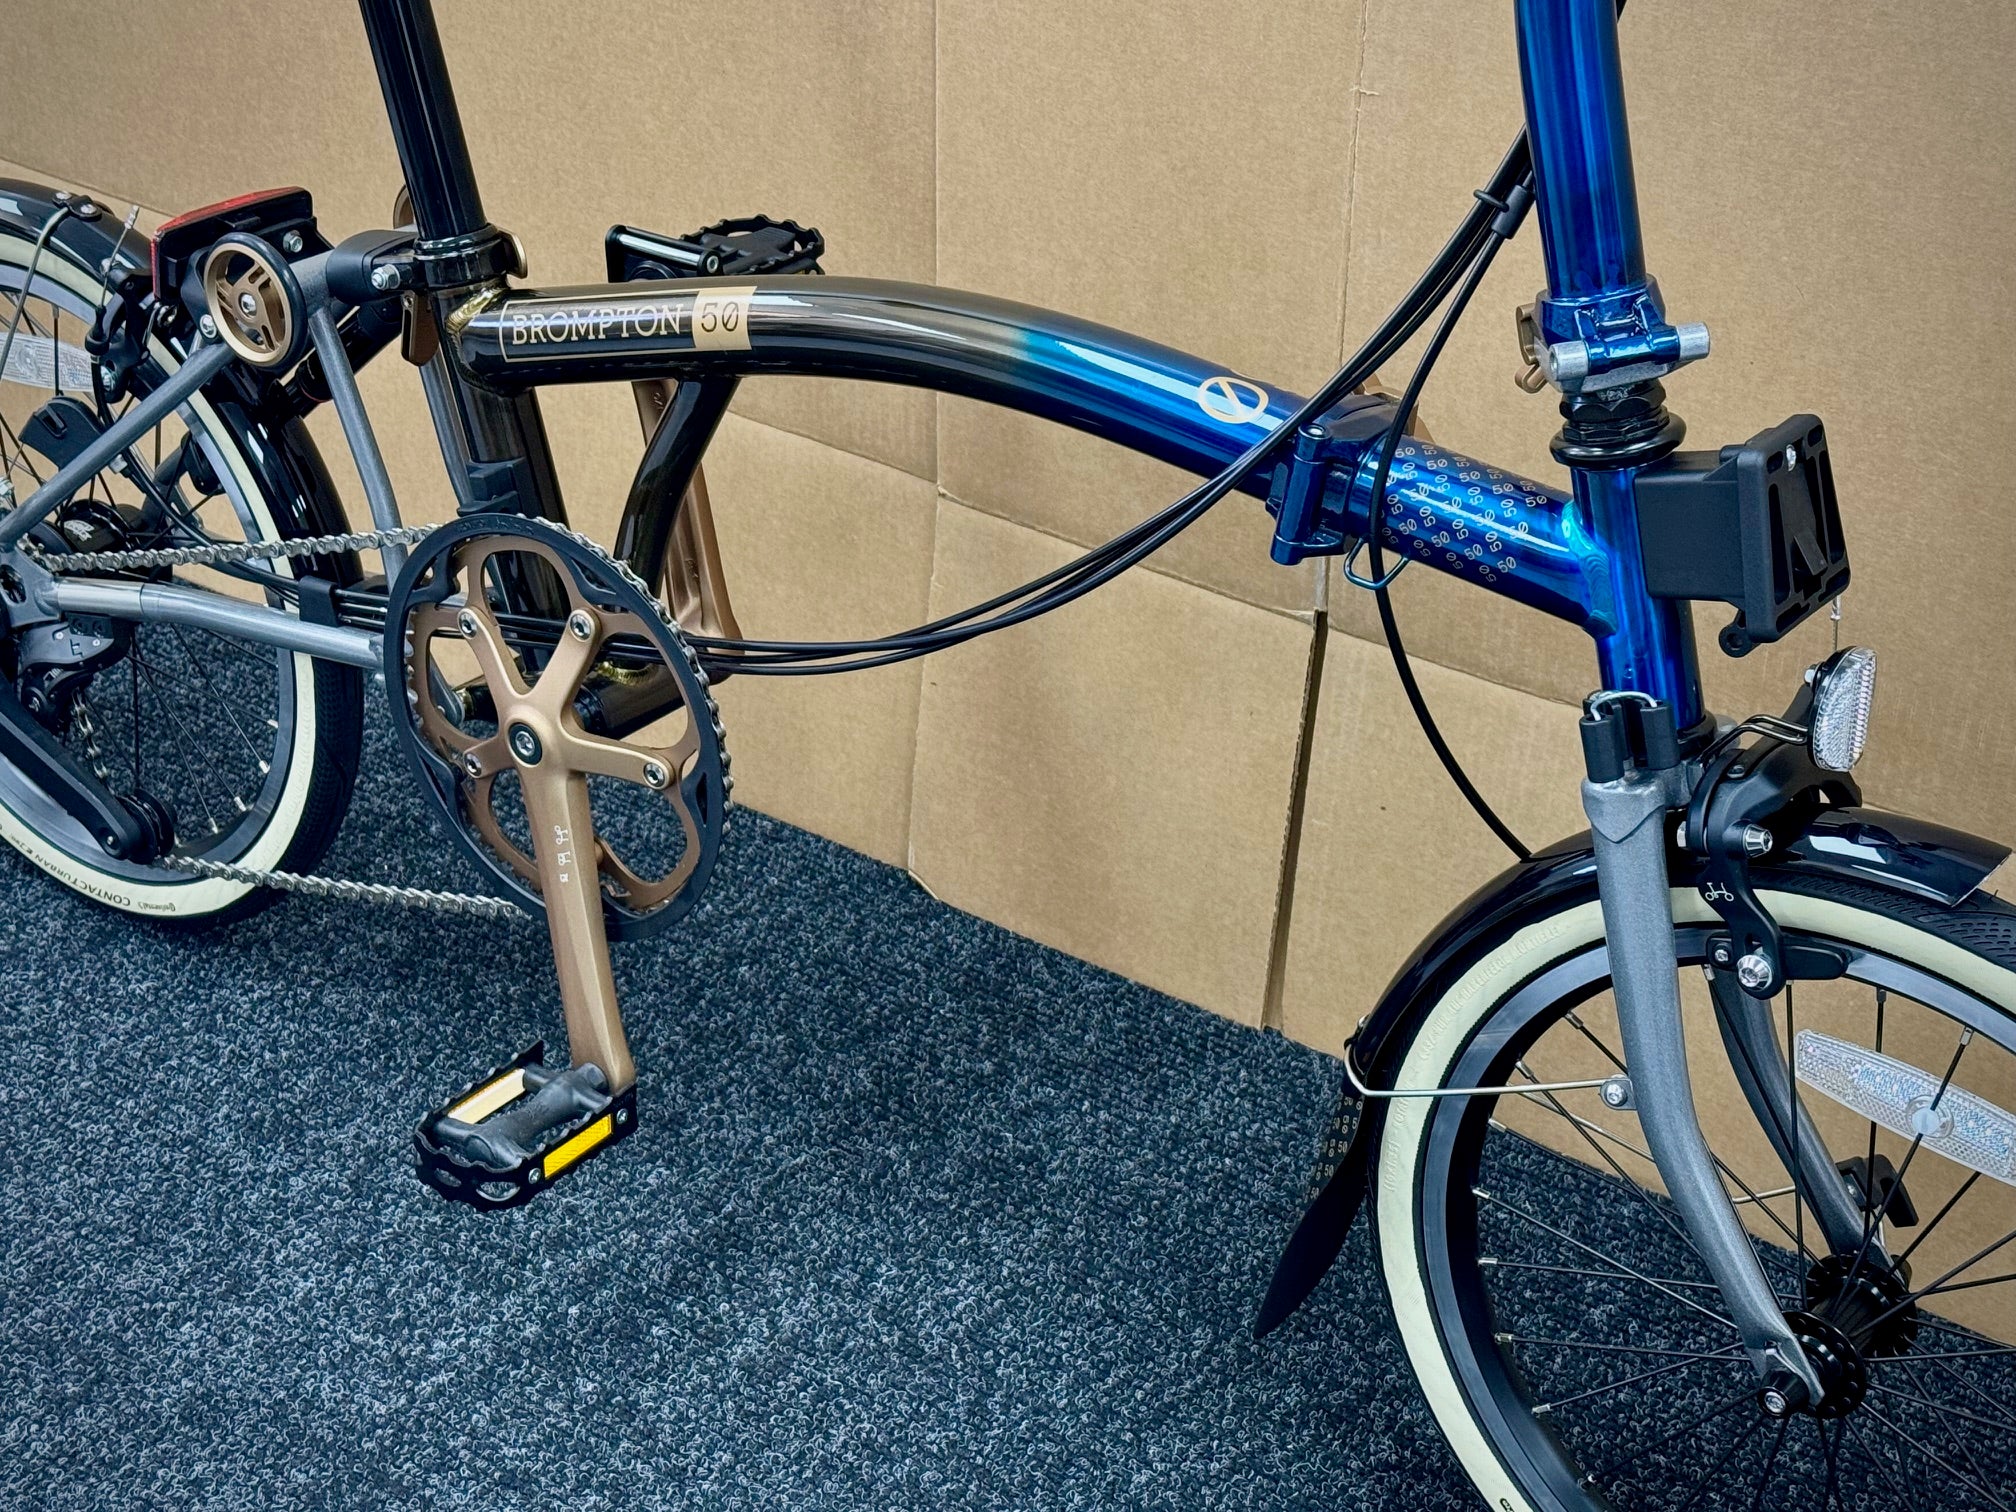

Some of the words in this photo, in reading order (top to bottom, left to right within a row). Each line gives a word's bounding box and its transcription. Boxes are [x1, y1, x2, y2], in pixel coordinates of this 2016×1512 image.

[511, 303, 684, 345] BROMPTON
[700, 301, 739, 333] 50
[1426, 459, 1447, 470] 50
[1459, 470, 1480, 482] 50
[1492, 482, 1513, 494] 50
[1525, 496, 1547, 507] 50
[1431, 531, 1450, 548] 50
[1464, 544, 1482, 560] 50
[1497, 556, 1516, 574] 50
